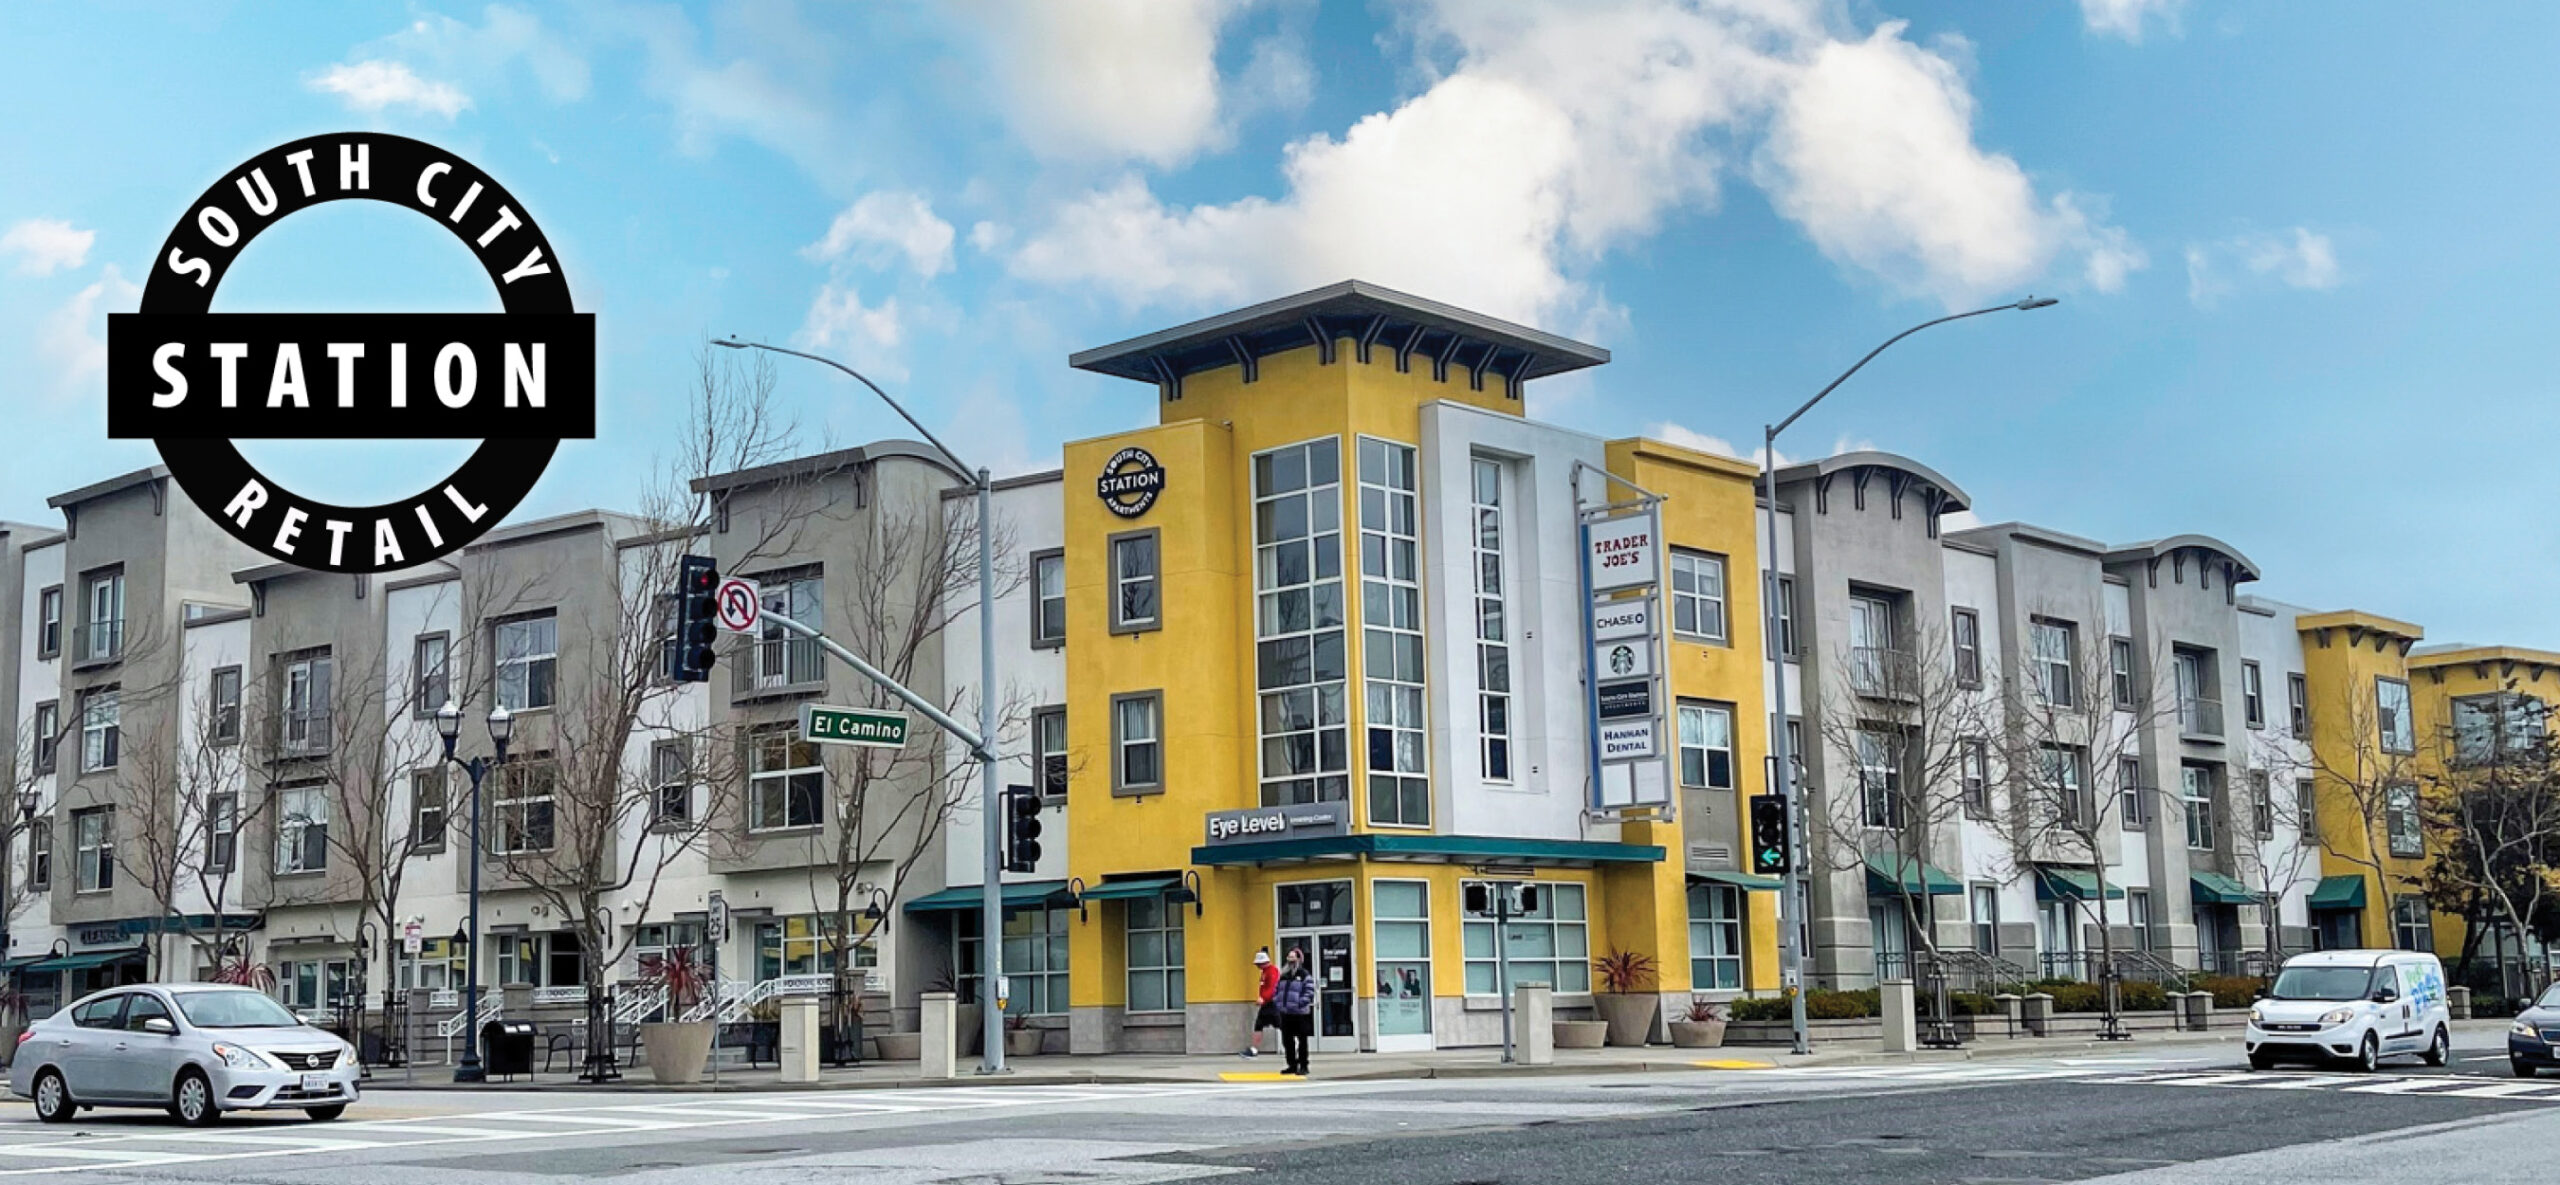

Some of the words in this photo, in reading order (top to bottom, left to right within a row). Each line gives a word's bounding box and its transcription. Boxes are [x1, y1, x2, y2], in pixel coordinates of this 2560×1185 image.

[1106, 450, 1134, 475] SOUTH
[1135, 451, 1153, 467] CITY
[1101, 471, 1159, 493] STATION
[1594, 534, 1648, 554] TRADER
[1602, 551, 1640, 568] JOE'S
[1596, 614, 1634, 628] CHASE
[815, 716, 832, 733] El
[839, 717, 901, 738] Camino
[1607, 741, 1647, 753] DENTAL
[1210, 817, 1239, 840] Eye
[1241, 812, 1286, 833] Level
[710, 915, 720, 936] 25
